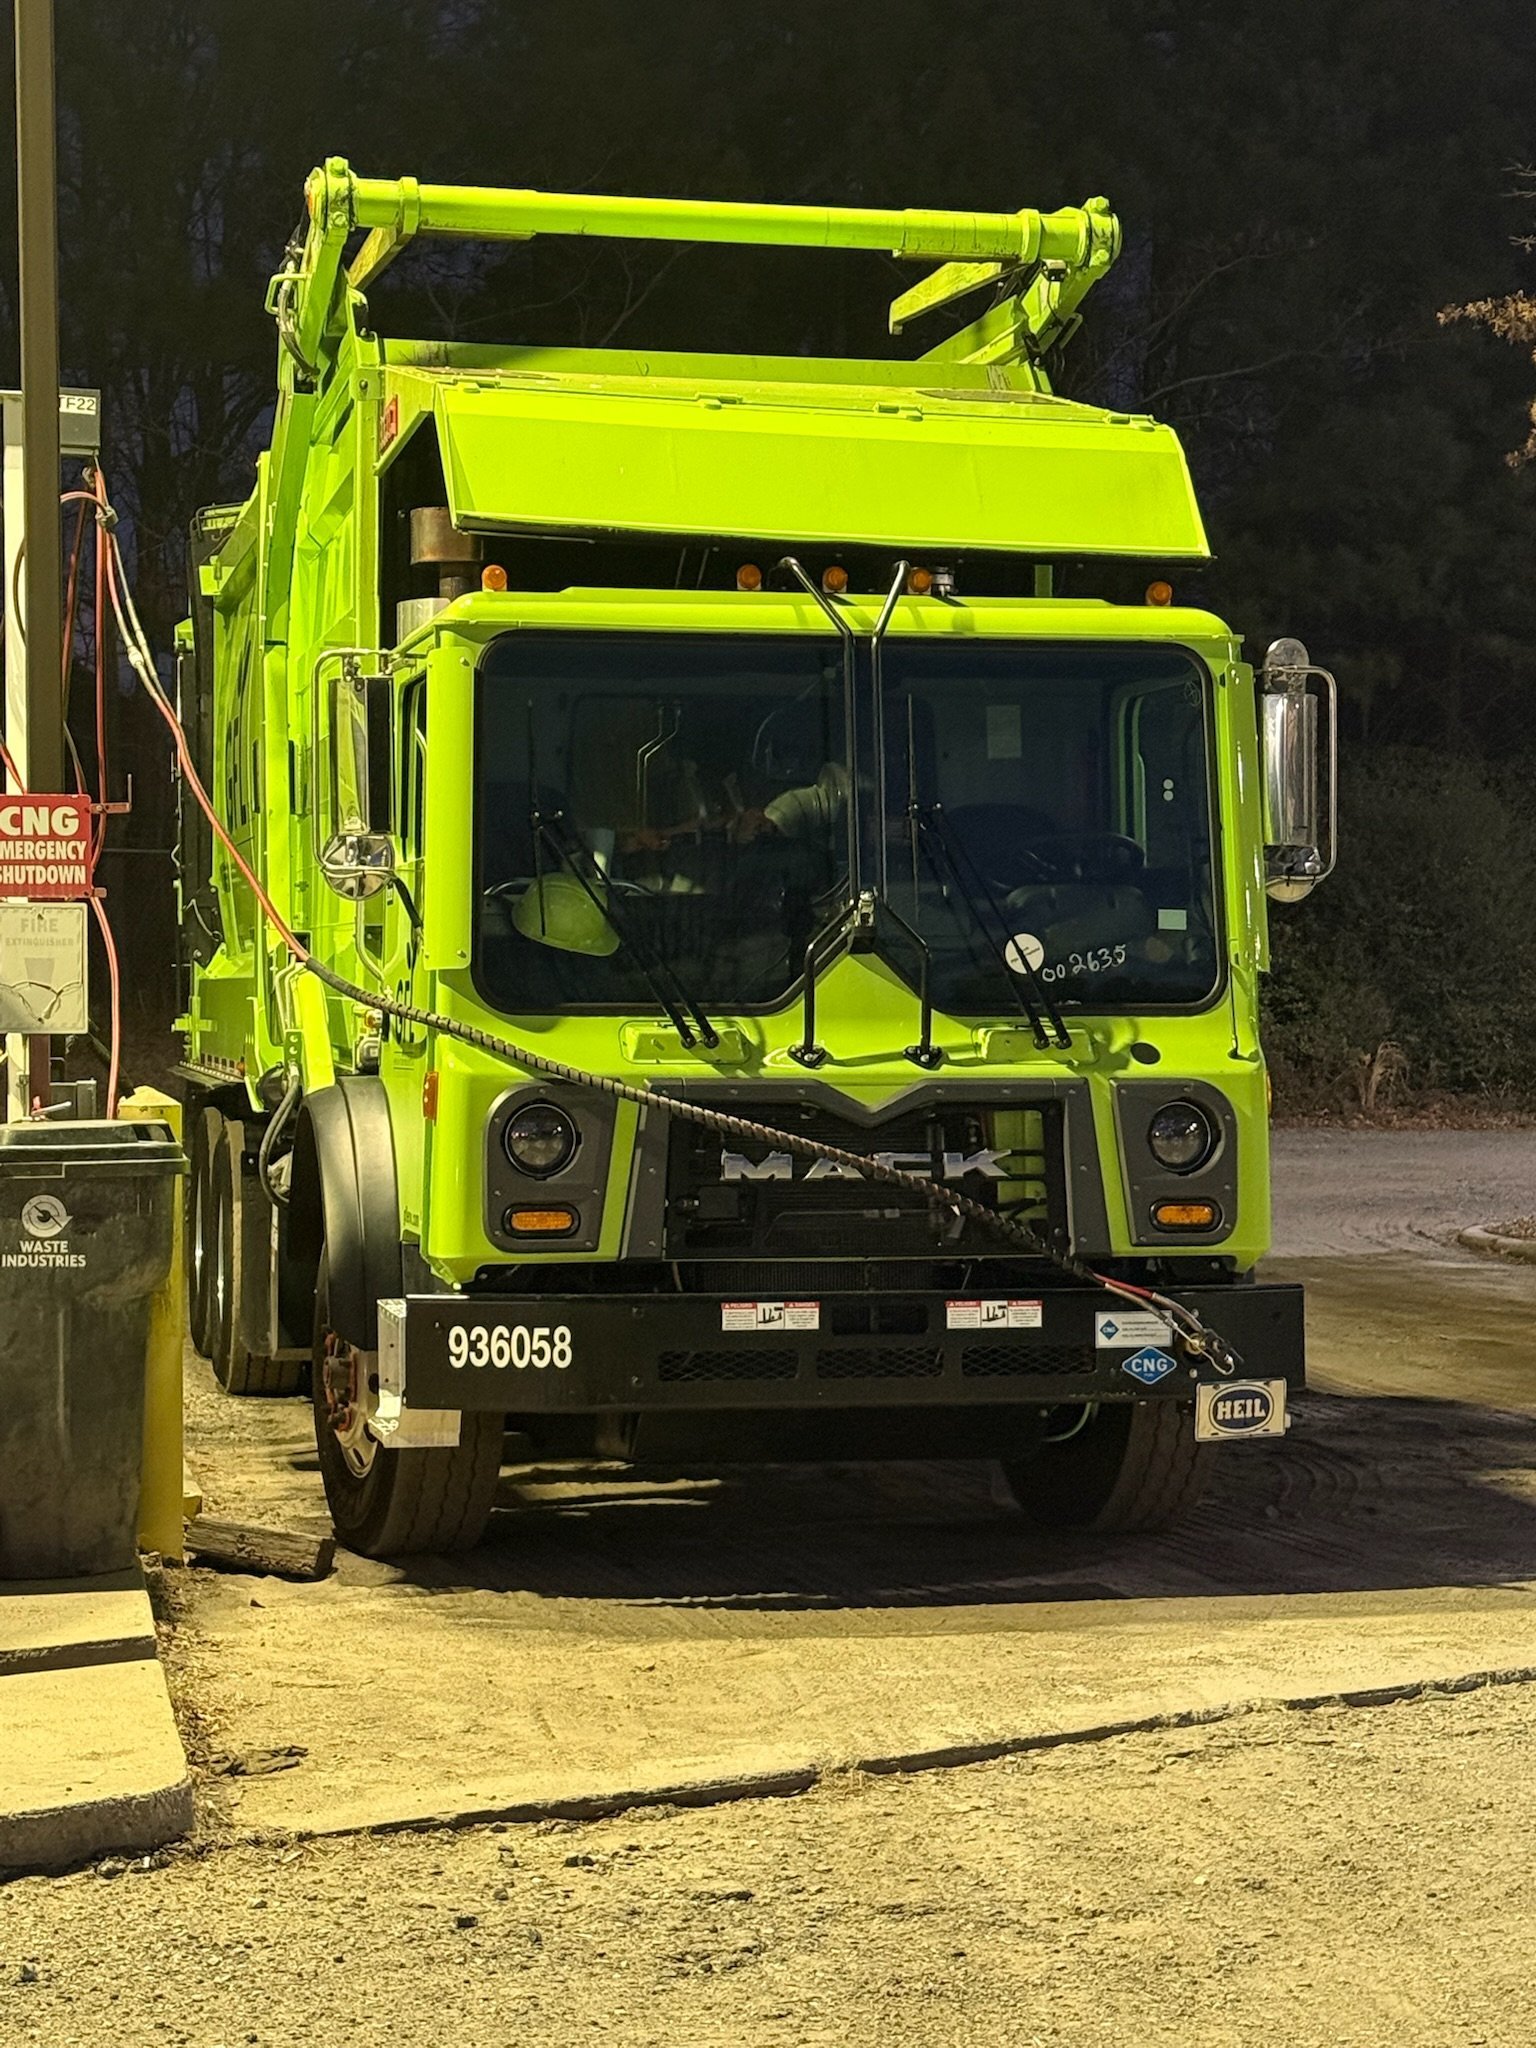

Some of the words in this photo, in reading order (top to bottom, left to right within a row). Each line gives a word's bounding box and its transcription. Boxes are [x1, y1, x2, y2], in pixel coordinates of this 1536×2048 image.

[60, 396, 96, 412] F22
[0, 806, 80, 836] CNG
[20, 918, 59, 933] FIRE
[5, 937, 75, 947] EXTINGUISHER
[720, 1149, 1012, 1180] MACK
[20, 1240, 69, 1254] WASTE
[1, 1254, 87, 1268] INDUSTRIES
[448, 1325, 573, 1369] 936058
[1131, 1358, 1168, 1373] CNG
[1216, 1398, 1266, 1421] HEIL
